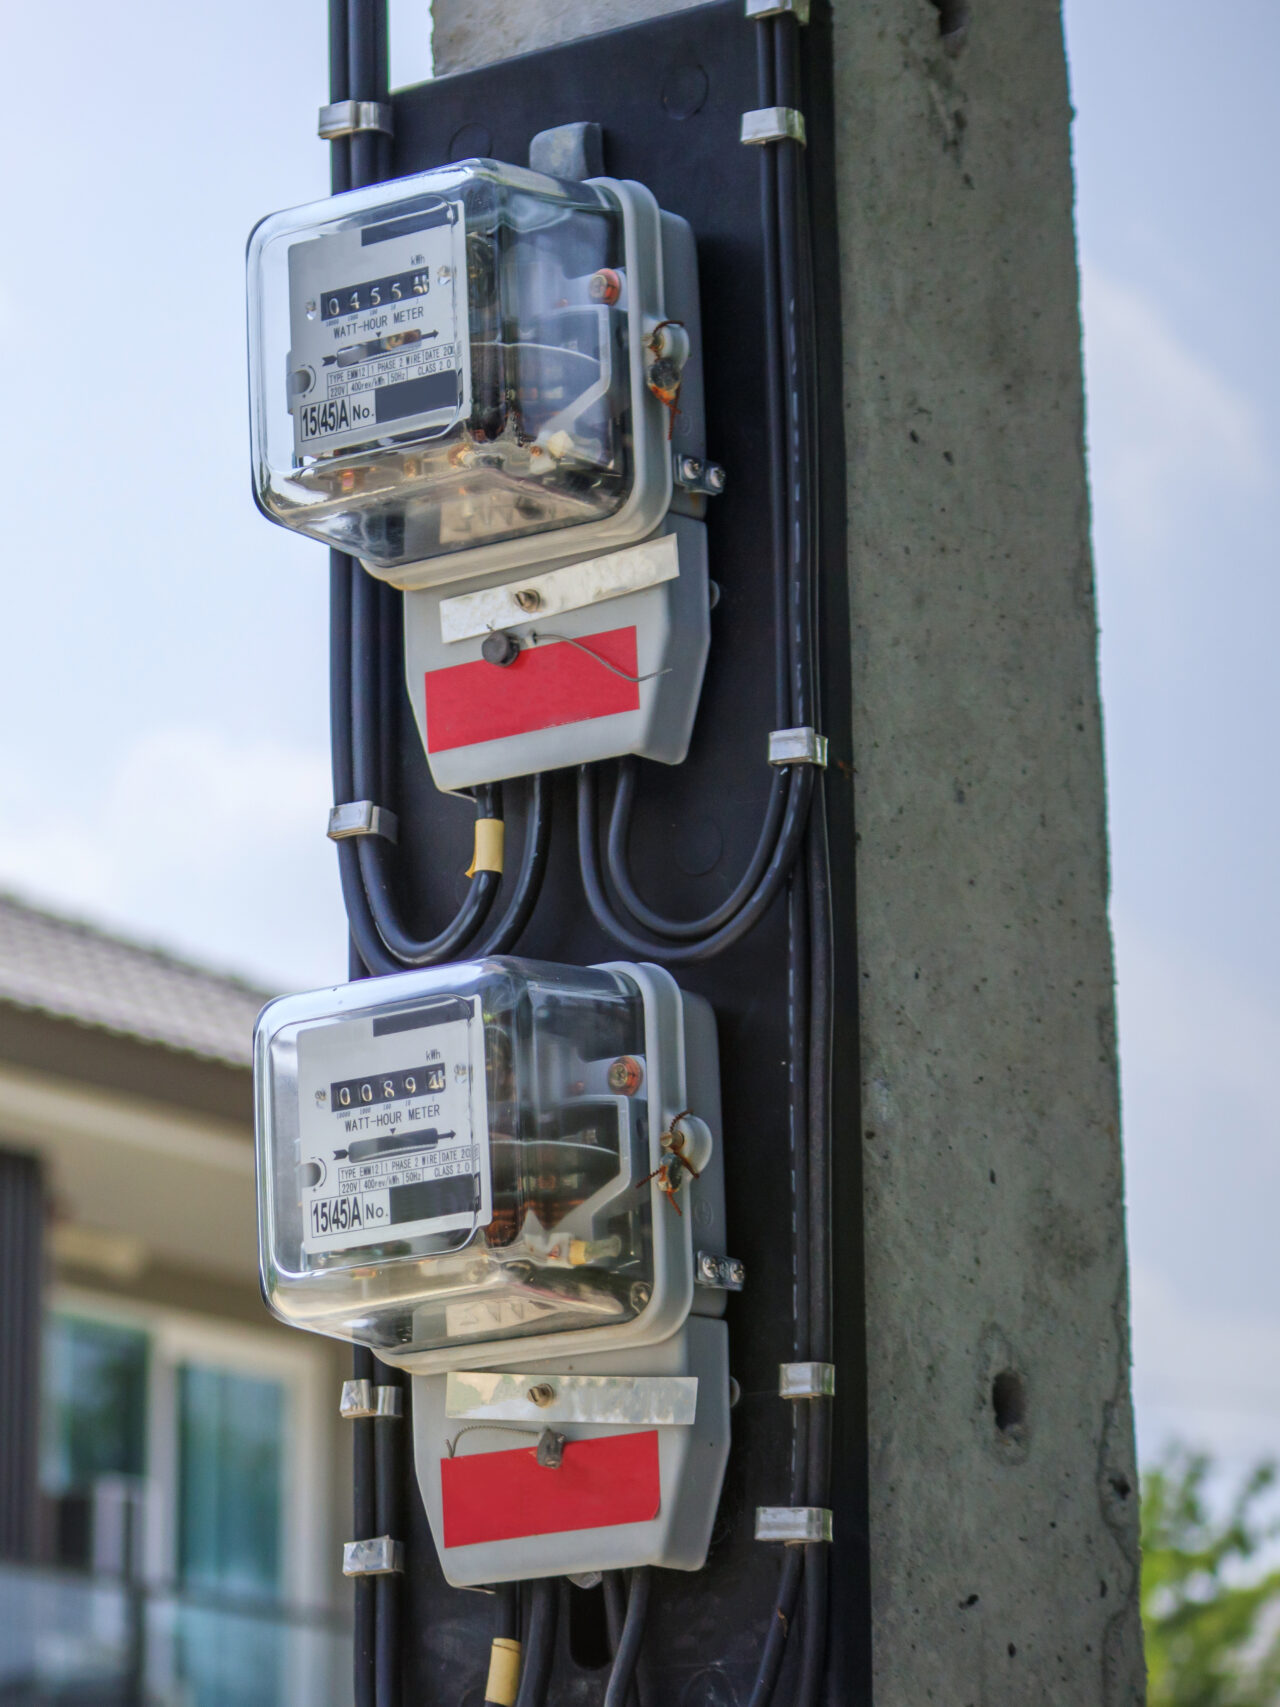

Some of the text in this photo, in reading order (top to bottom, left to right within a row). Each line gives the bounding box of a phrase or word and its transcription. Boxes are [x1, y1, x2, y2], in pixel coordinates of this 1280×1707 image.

[333, 306, 424, 339] WATT-HOUR METER
[329, 372, 344, 384] TYPE
[377, 360, 396, 372] PHASE
[399, 357, 403, 367] 2
[406, 353, 422, 365] WIRE
[424, 349, 440, 362] DATE
[330, 386, 345, 398] 220V
[390, 371, 406, 383] 50Hz
[418, 361, 436, 376] CLASS
[302, 399, 375, 436] 15(45)A No.
[425, 1049, 441, 1061] kWh
[344, 1104, 441, 1133] WATT-HOUR METER
[341, 1167, 356, 1180] TYPE
[392, 1158, 411, 1171] PHASE
[415, 1157, 419, 1167] 2
[422, 1153, 438, 1165] WIRE
[441, 1150, 457, 1163] DATE
[342, 1183, 358, 1194] 220V
[405, 1170, 421, 1182] 50Hz
[434, 1164, 453, 1176] CLASS
[313, 1197, 389, 1233] 15(45)A No.
